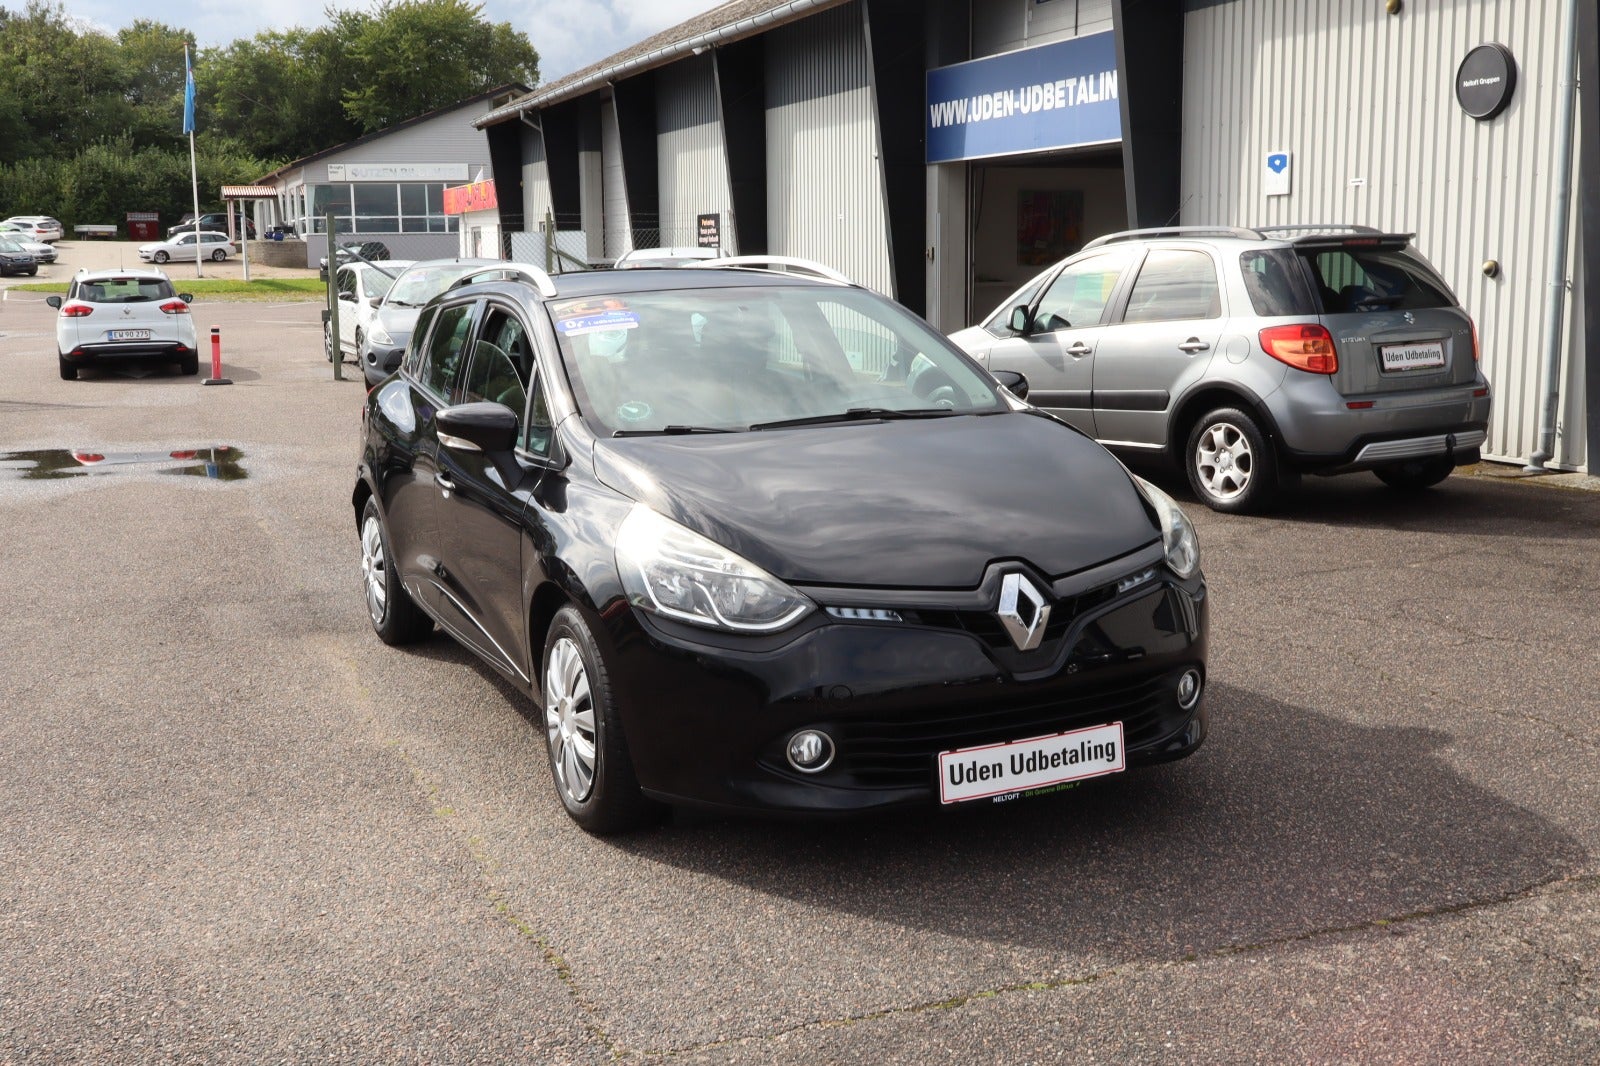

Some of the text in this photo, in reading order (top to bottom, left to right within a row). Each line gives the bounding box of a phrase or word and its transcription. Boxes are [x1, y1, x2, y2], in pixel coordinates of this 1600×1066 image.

[1480, 77, 1500, 85] Gruppen
[1385, 349, 1441, 362] Uden Udbetaling
[949, 740, 1116, 786] Uden Udbetaling
